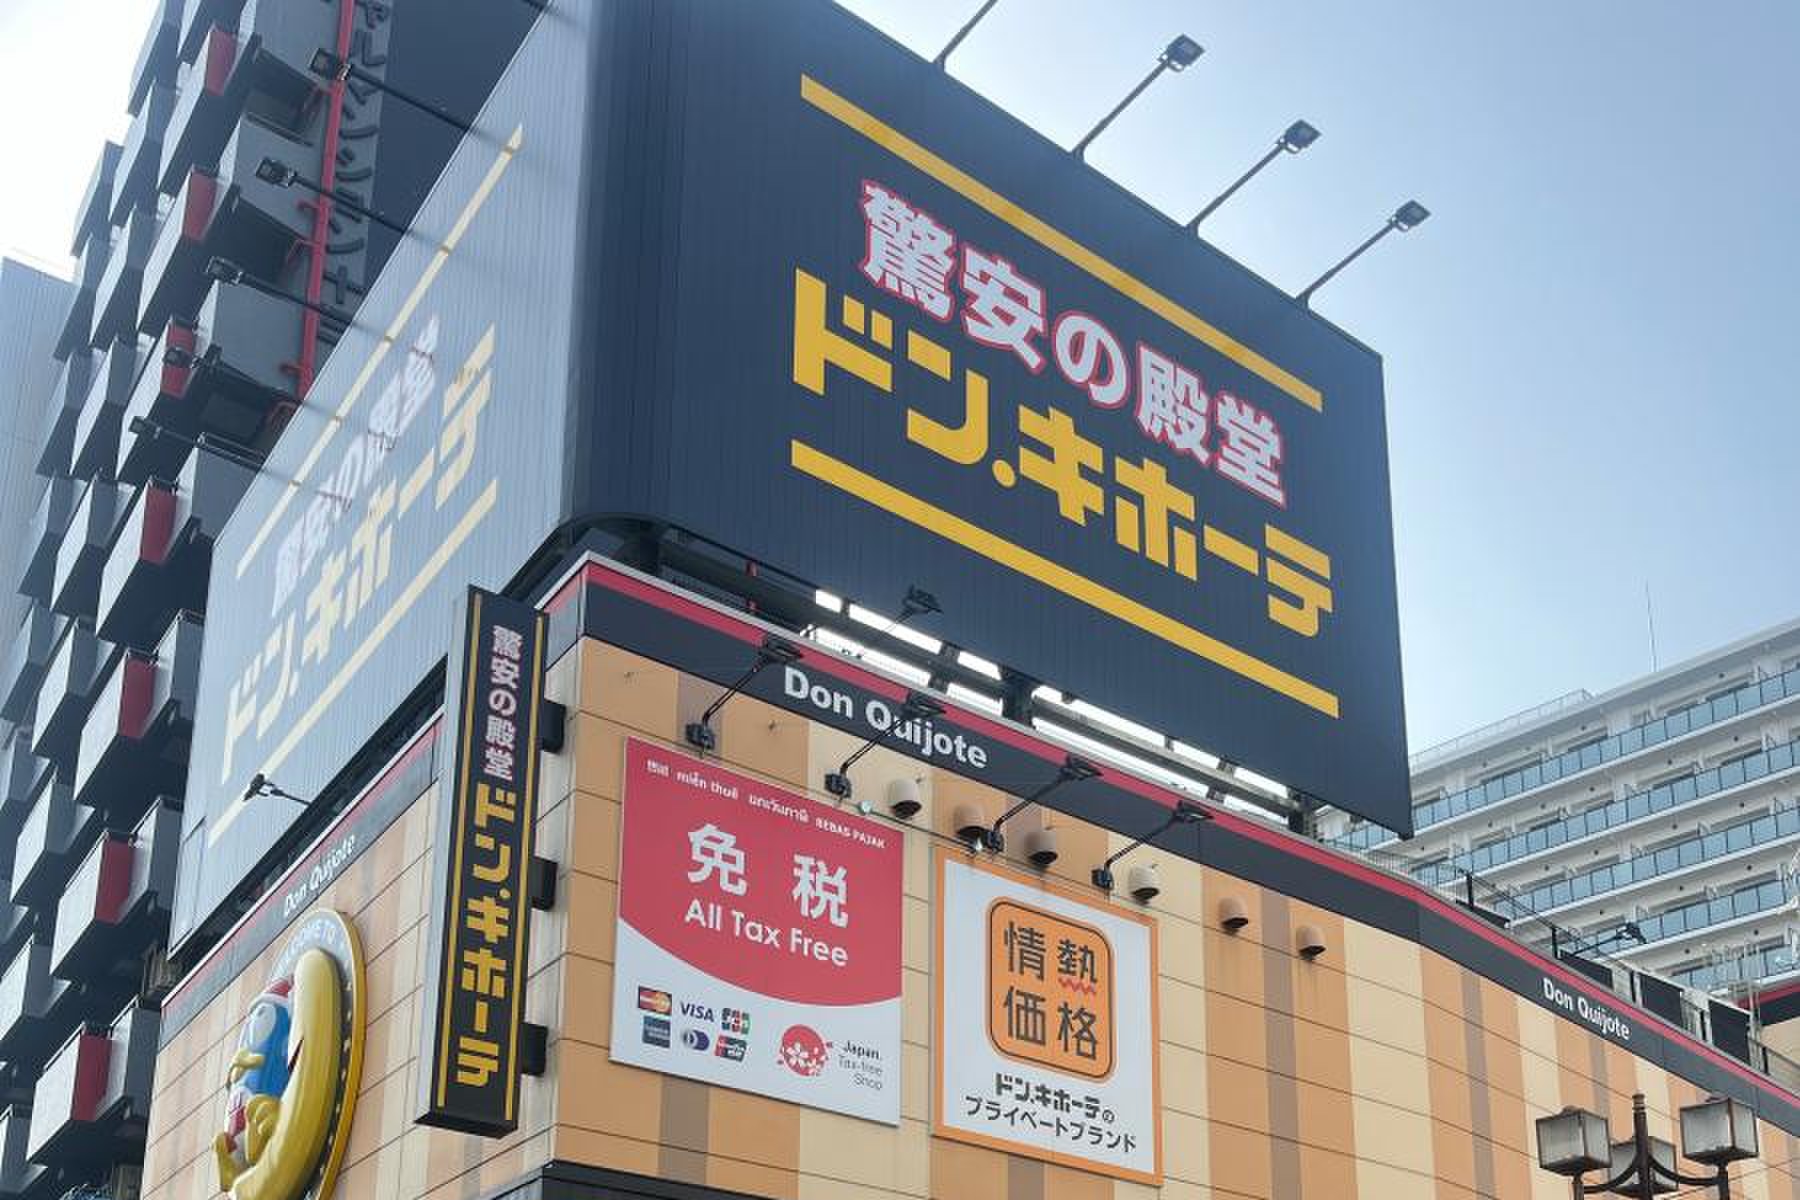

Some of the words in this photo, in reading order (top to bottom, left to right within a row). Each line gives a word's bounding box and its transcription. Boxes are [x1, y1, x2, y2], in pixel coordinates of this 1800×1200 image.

[861, 178, 1287, 508] 驚安の殿堂
[483, 623, 524, 782] 驚安の殿堂
[783, 665, 853, 719] Don
[864, 700, 989, 770] Quijote
[684, 898, 722, 932] All
[732, 909, 781, 949] Tax
[790, 927, 849, 967] Free
[680, 1001, 715, 1023] VISA
[1543, 977, 1574, 1011] Don
[1577, 996, 1631, 1041] Quijote
[965, 1094, 1137, 1154] プライベートブランド
